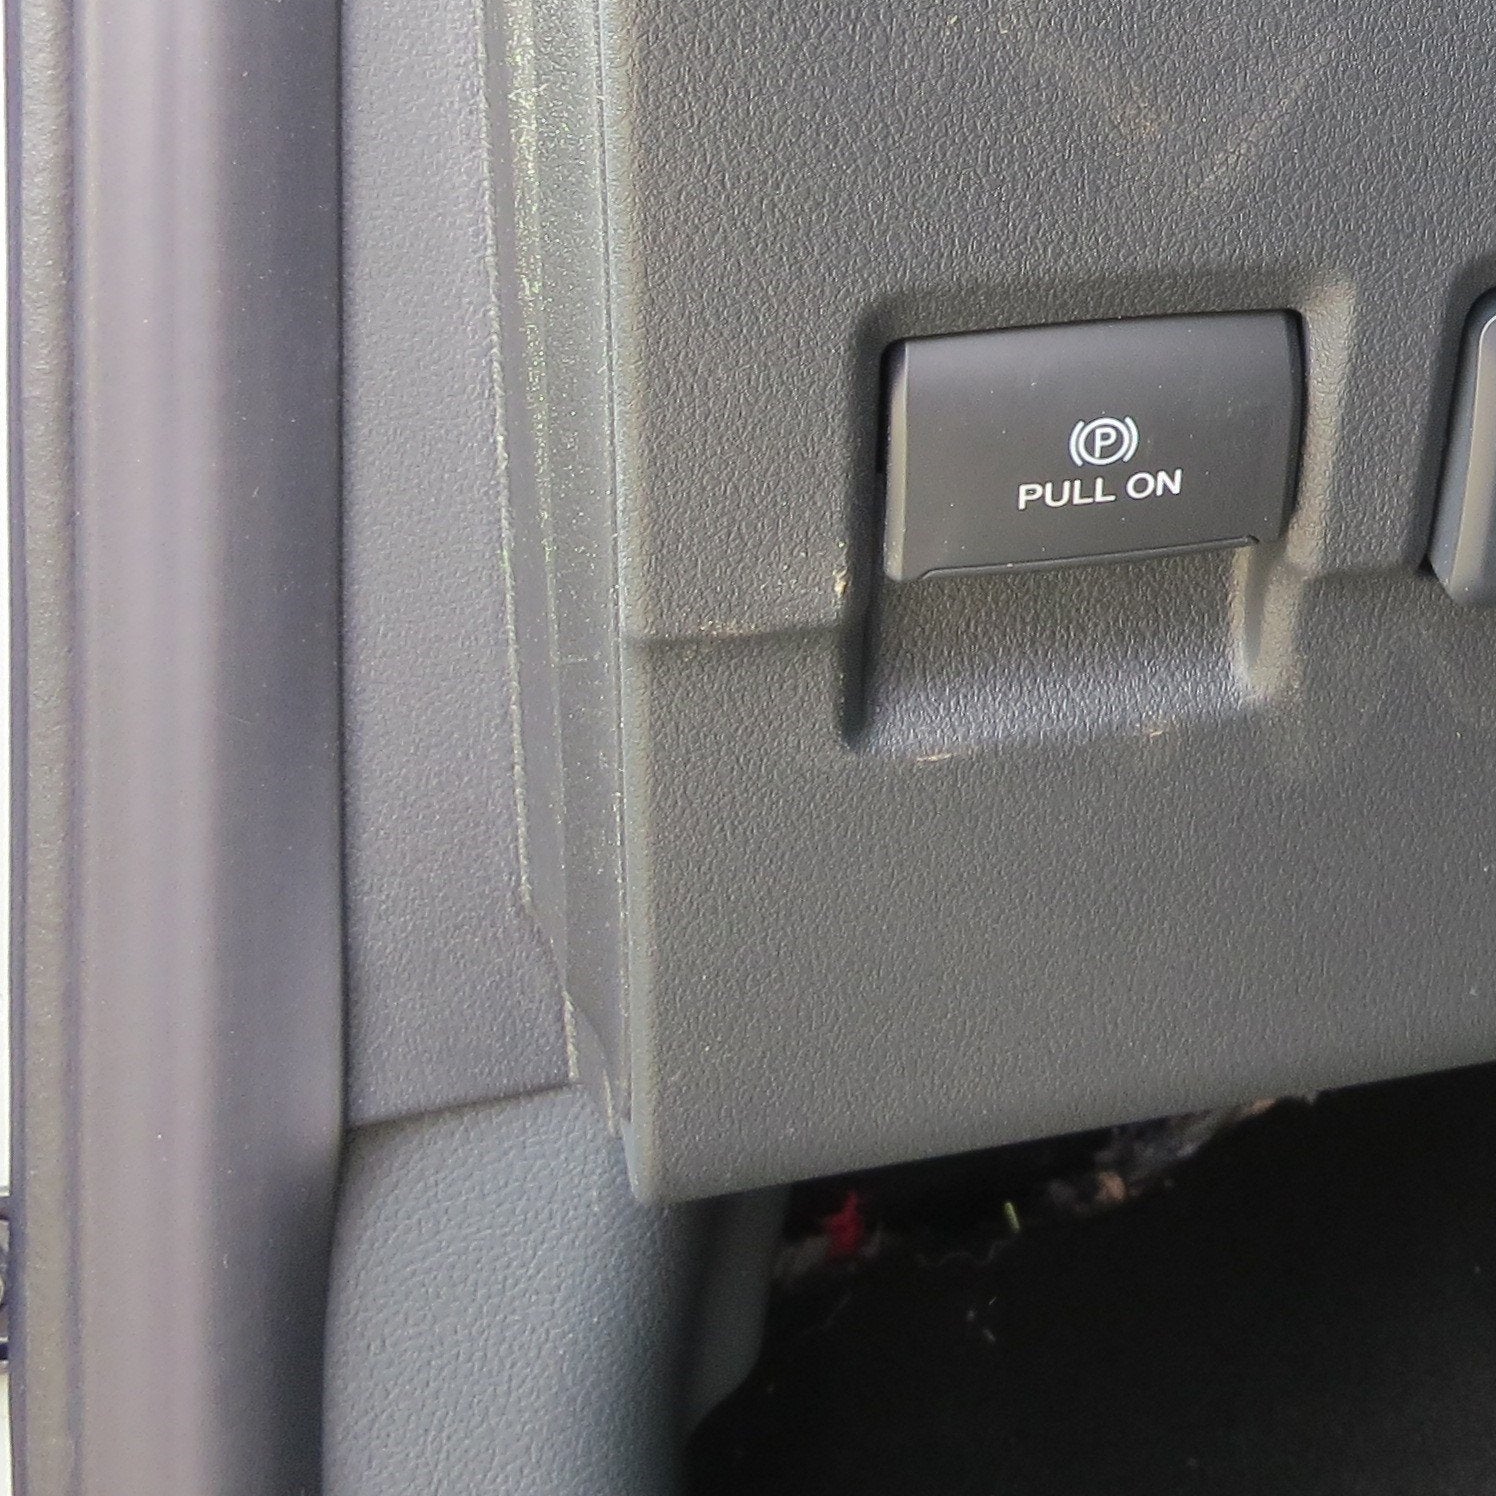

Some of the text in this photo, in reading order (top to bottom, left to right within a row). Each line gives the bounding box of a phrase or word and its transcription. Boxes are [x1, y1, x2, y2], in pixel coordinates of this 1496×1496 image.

[1094, 426, 1117, 458] P
[1017, 468, 1182, 510] PULL ON
